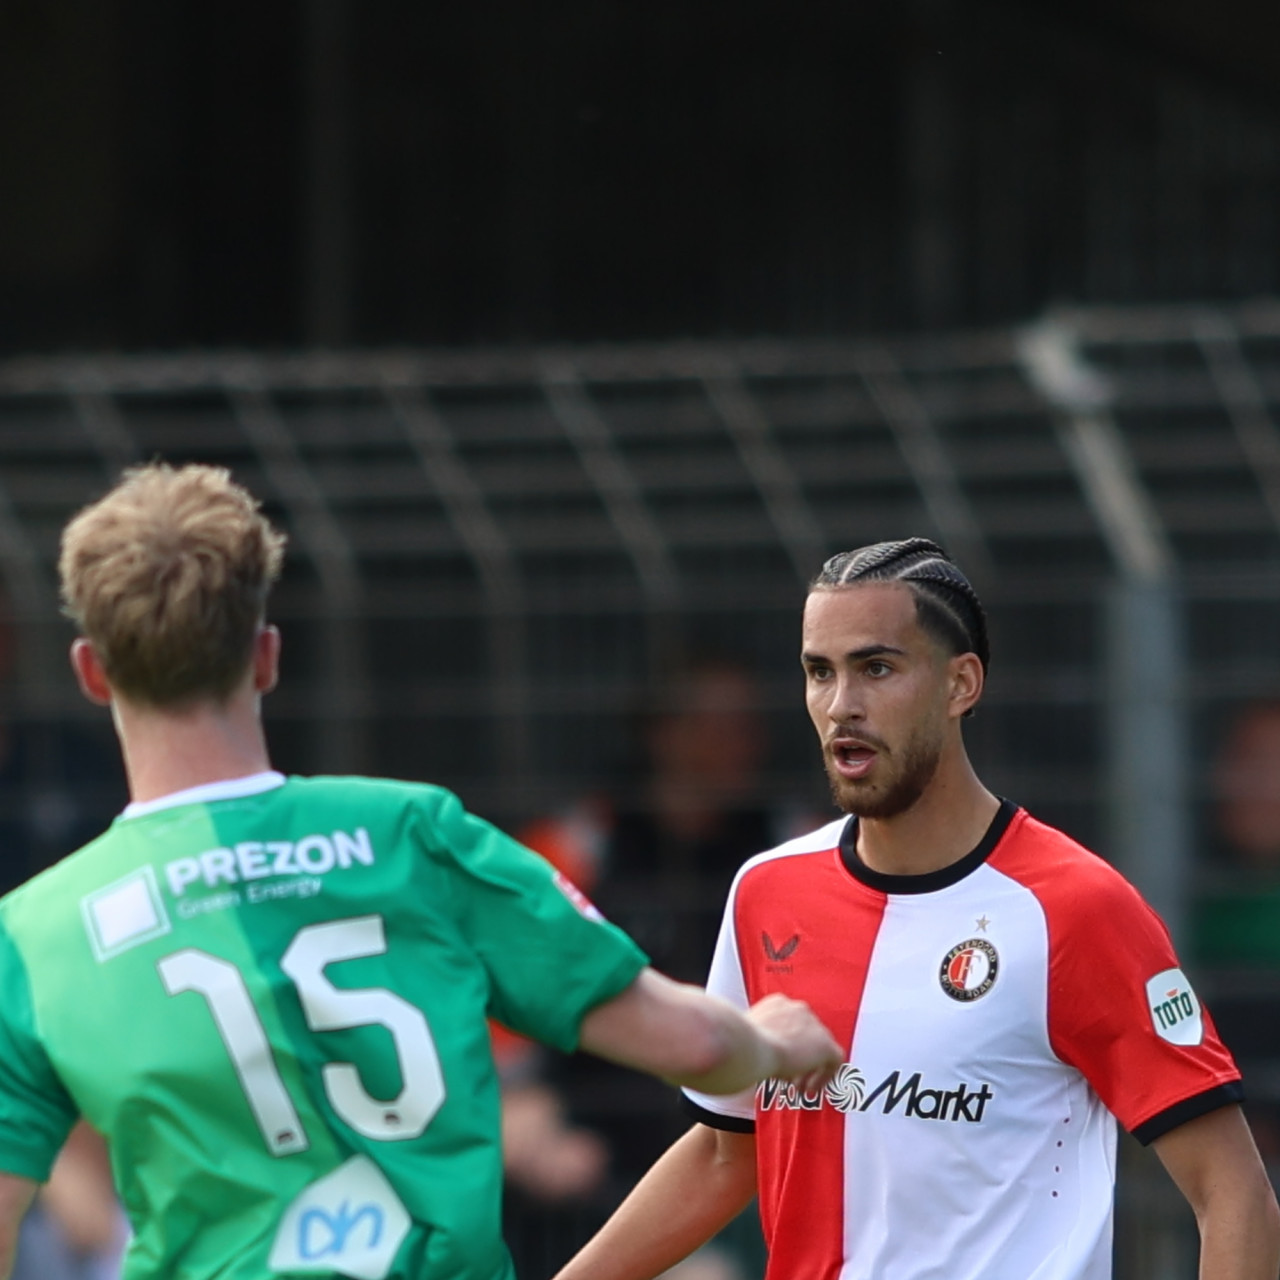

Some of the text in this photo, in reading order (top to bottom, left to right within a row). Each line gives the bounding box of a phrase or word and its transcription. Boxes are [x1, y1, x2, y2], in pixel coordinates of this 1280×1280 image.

[166, 826, 374, 897] PREZON
[246, 876, 323, 904] Energy
[154, 913, 447, 1158] 15
[1153, 991, 1194, 1030] TOTO
[858, 1069, 995, 1123] Markt
